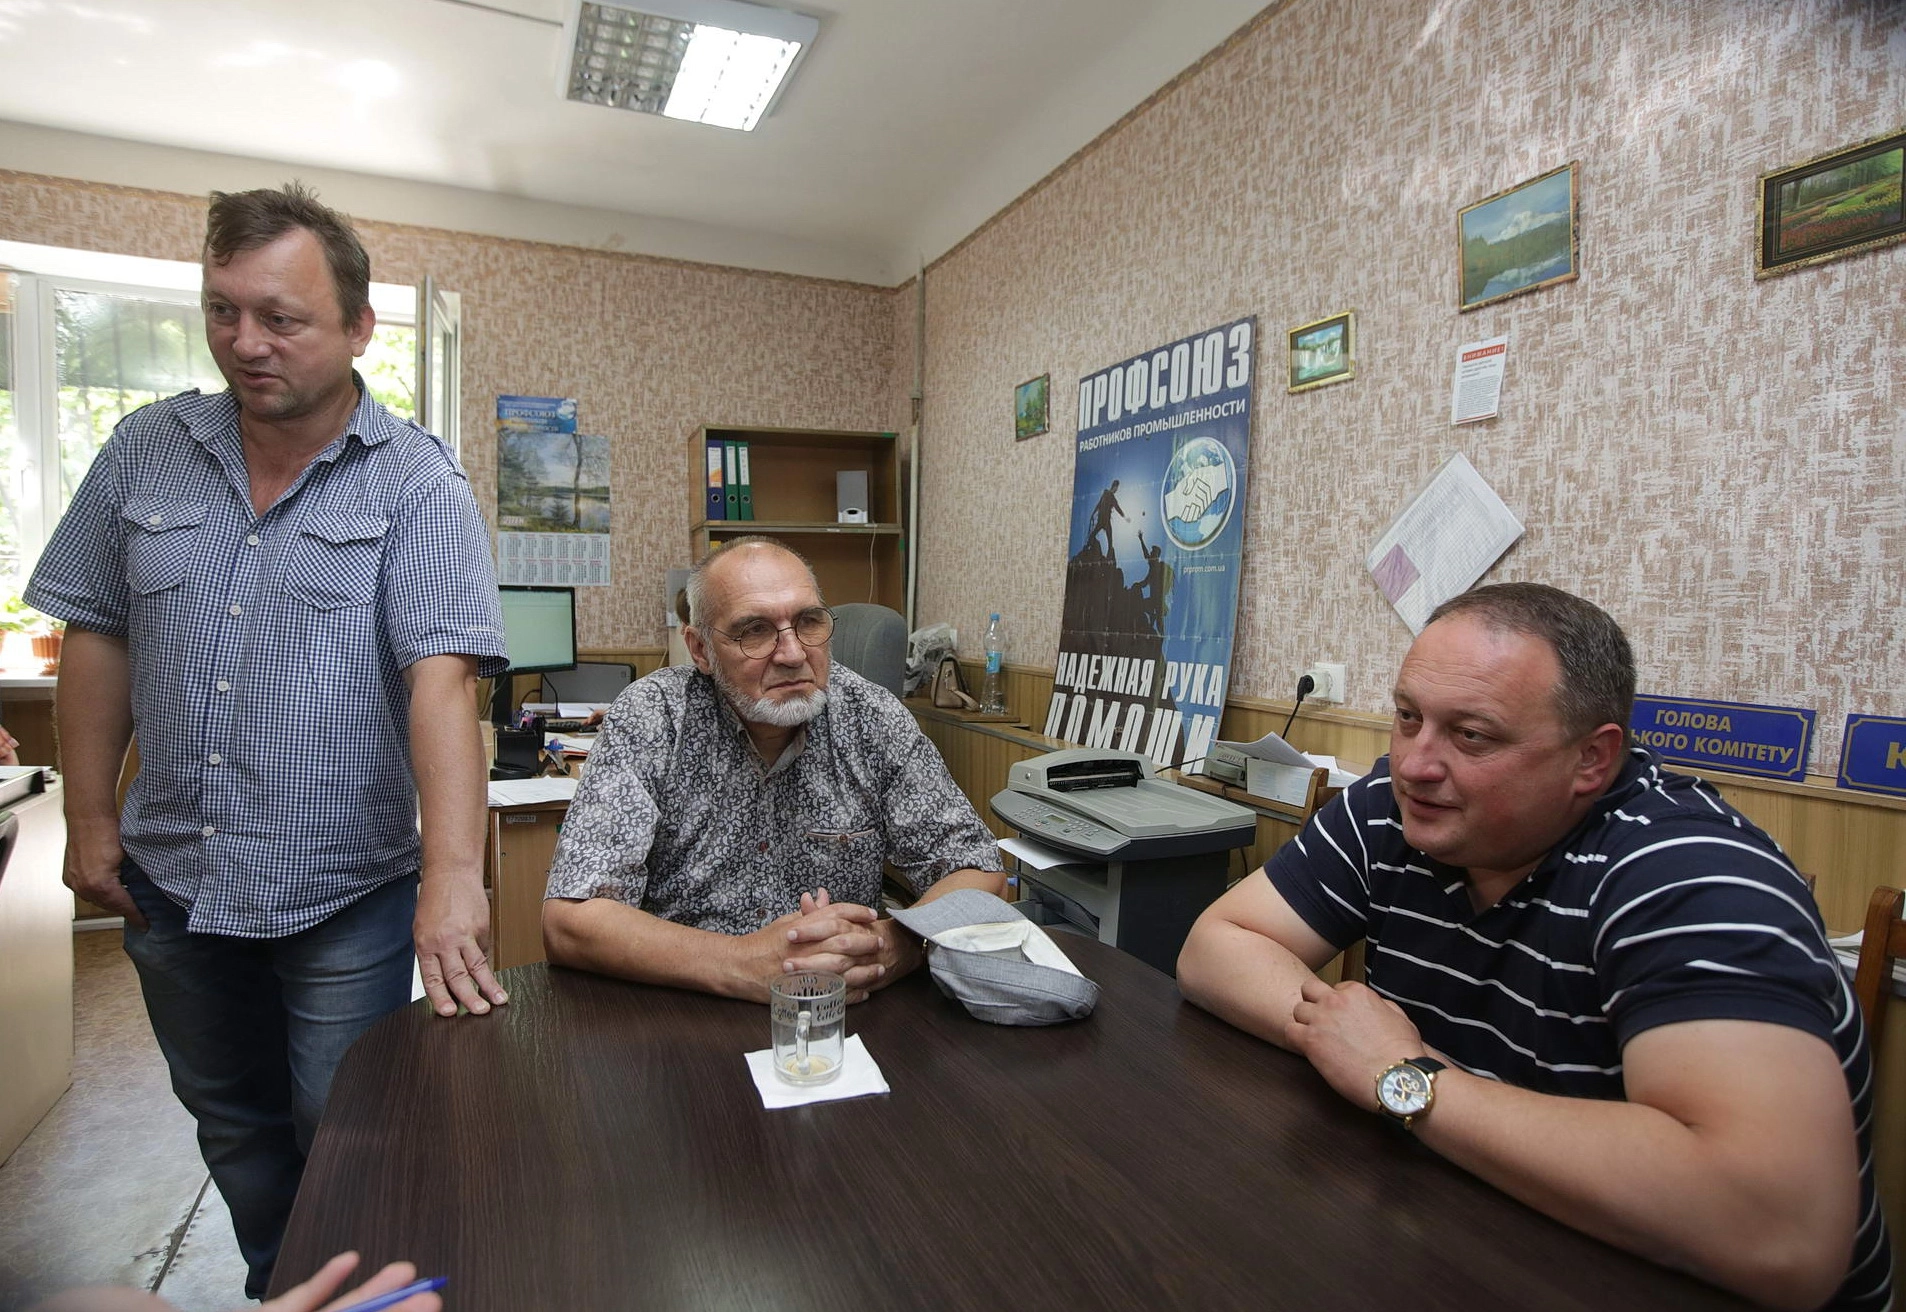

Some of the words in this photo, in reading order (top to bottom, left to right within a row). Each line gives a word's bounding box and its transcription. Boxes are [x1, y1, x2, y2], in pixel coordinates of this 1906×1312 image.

[1078, 322, 1251, 431] ПРОФСОЮЗ
[1079, 426, 1132, 452] РАБОТНИКОВ
[1133, 399, 1246, 438] ПРОМЫШЛЕННОСТИ
[1055, 652, 1156, 698] НАДЕЖНАЯ
[1161, 661, 1224, 707] РУКА
[1655, 709, 1732, 732] ГОЛОВА
[1694, 736, 1795, 764] КОМІТЕТУ
